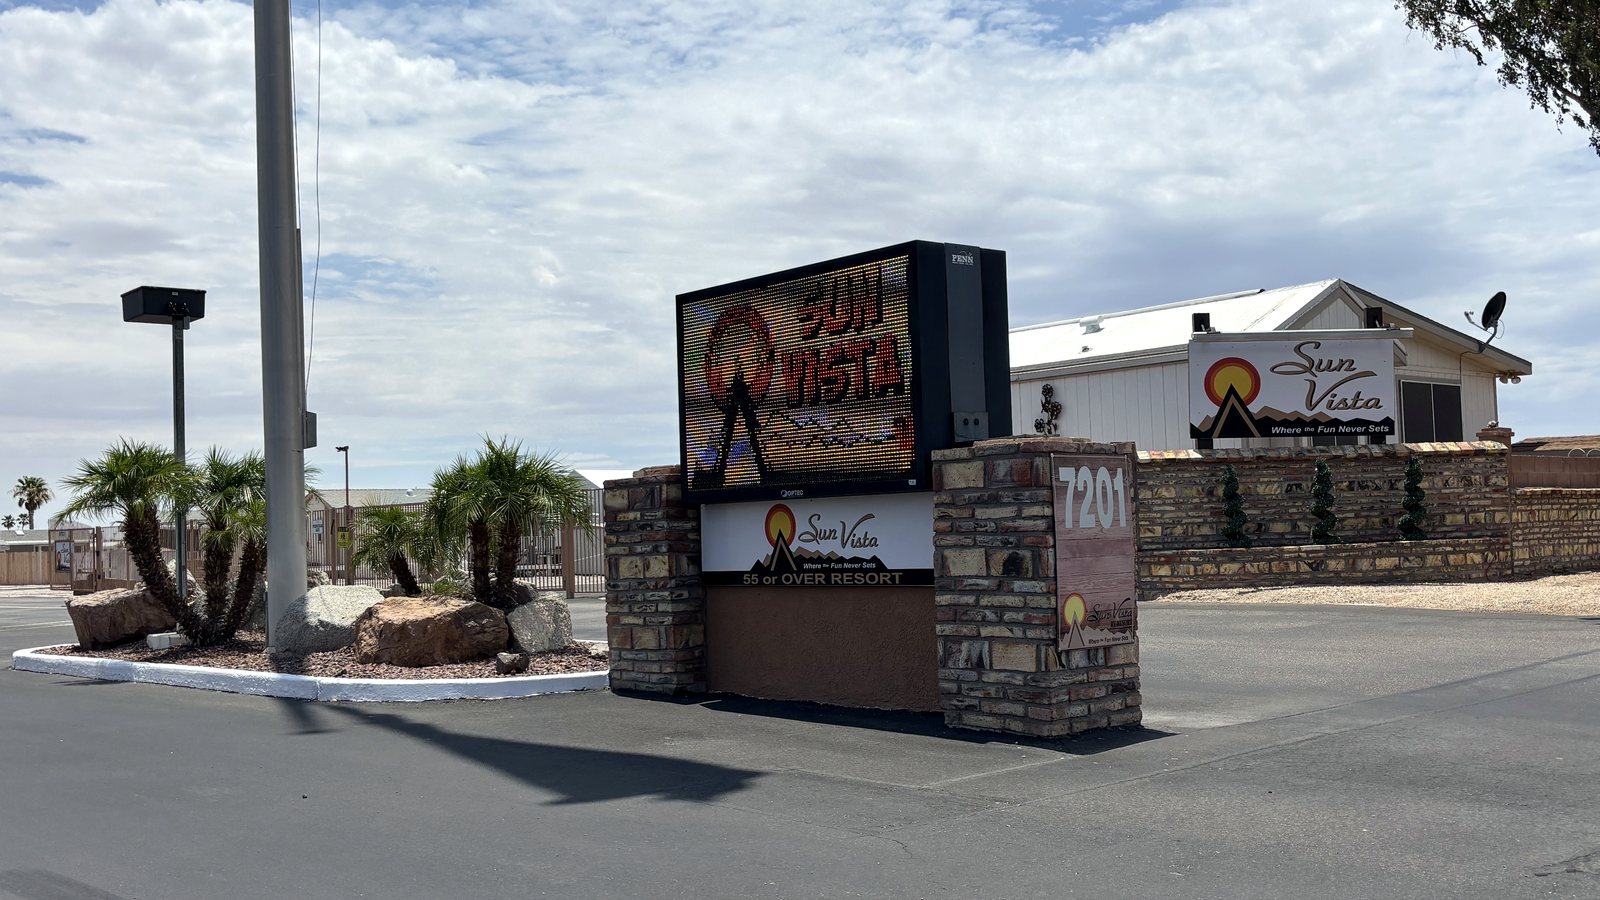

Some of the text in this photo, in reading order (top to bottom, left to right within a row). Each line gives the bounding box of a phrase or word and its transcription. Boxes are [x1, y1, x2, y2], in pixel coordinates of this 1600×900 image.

[952, 254, 974, 264] PENN
[781, 332, 902, 403] VISTA
[1269, 341, 1358, 378] Sun
[1303, 370, 1384, 412] Vista
[1271, 426, 1302, 434] Where
[1317, 425, 1336, 433] Fun
[1338, 425, 1367, 433] Never
[1368, 424, 1390, 433] Sets
[1058, 465, 1127, 529] 7201
[798, 512, 880, 550] Sun Vista
[743, 572, 904, 585] 55 or OVER RESORT
[803, 562, 822, 570] Where
[862, 561, 877, 569] Sets
[1087, 603, 1111, 623] Sun
